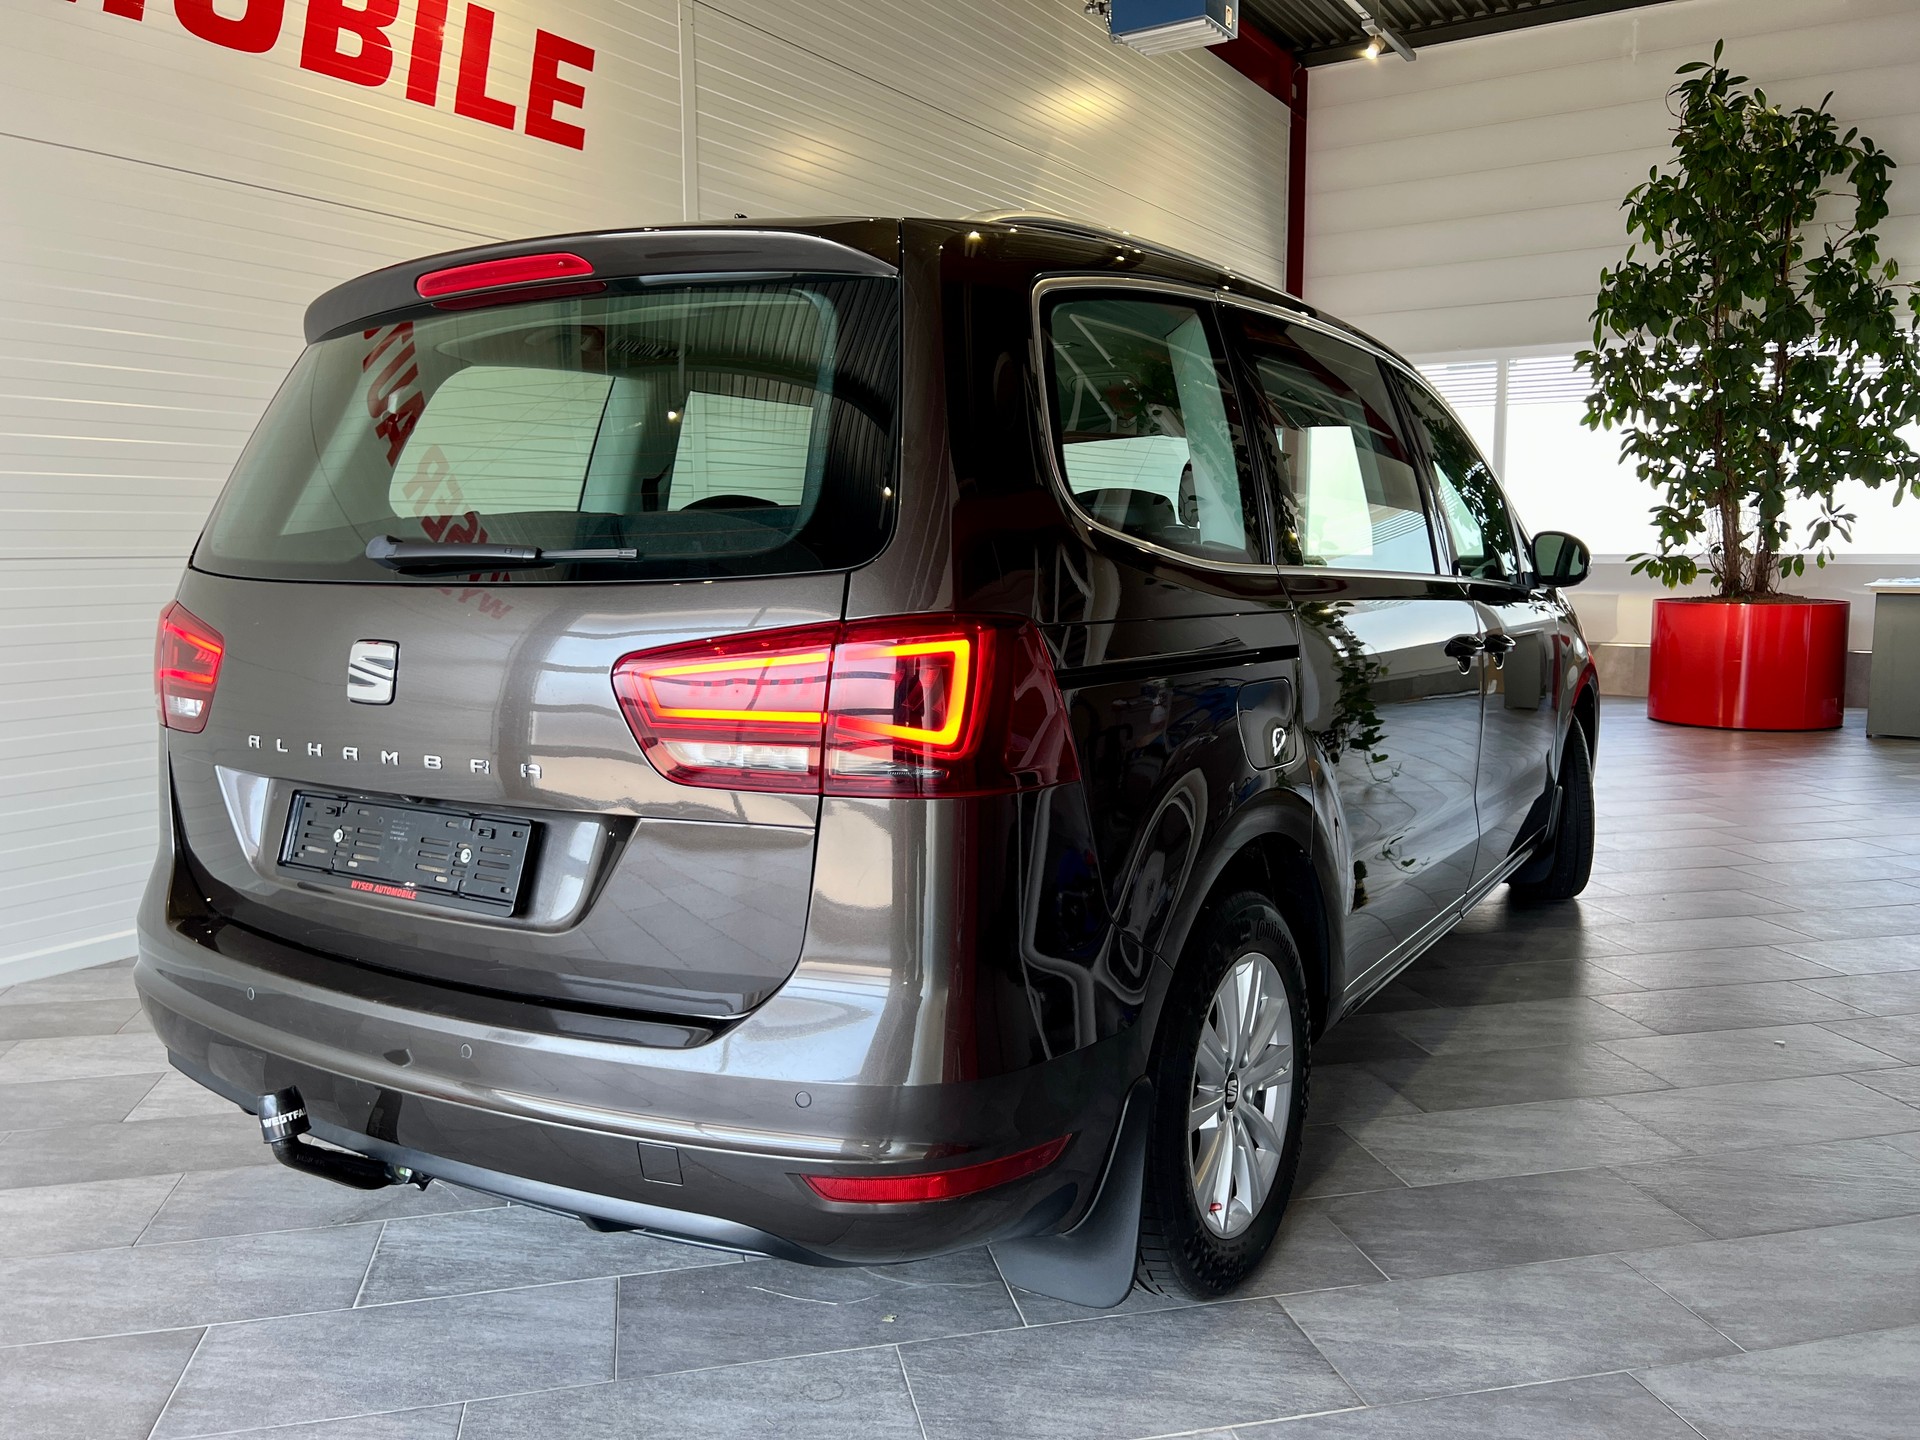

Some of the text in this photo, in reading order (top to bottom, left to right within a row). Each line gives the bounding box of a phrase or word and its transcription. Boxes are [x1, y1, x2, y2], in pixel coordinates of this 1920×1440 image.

[248, 734, 542, 779] ALHAMBRA
[351, 880, 417, 899] WYSER AUTOMOBILE
